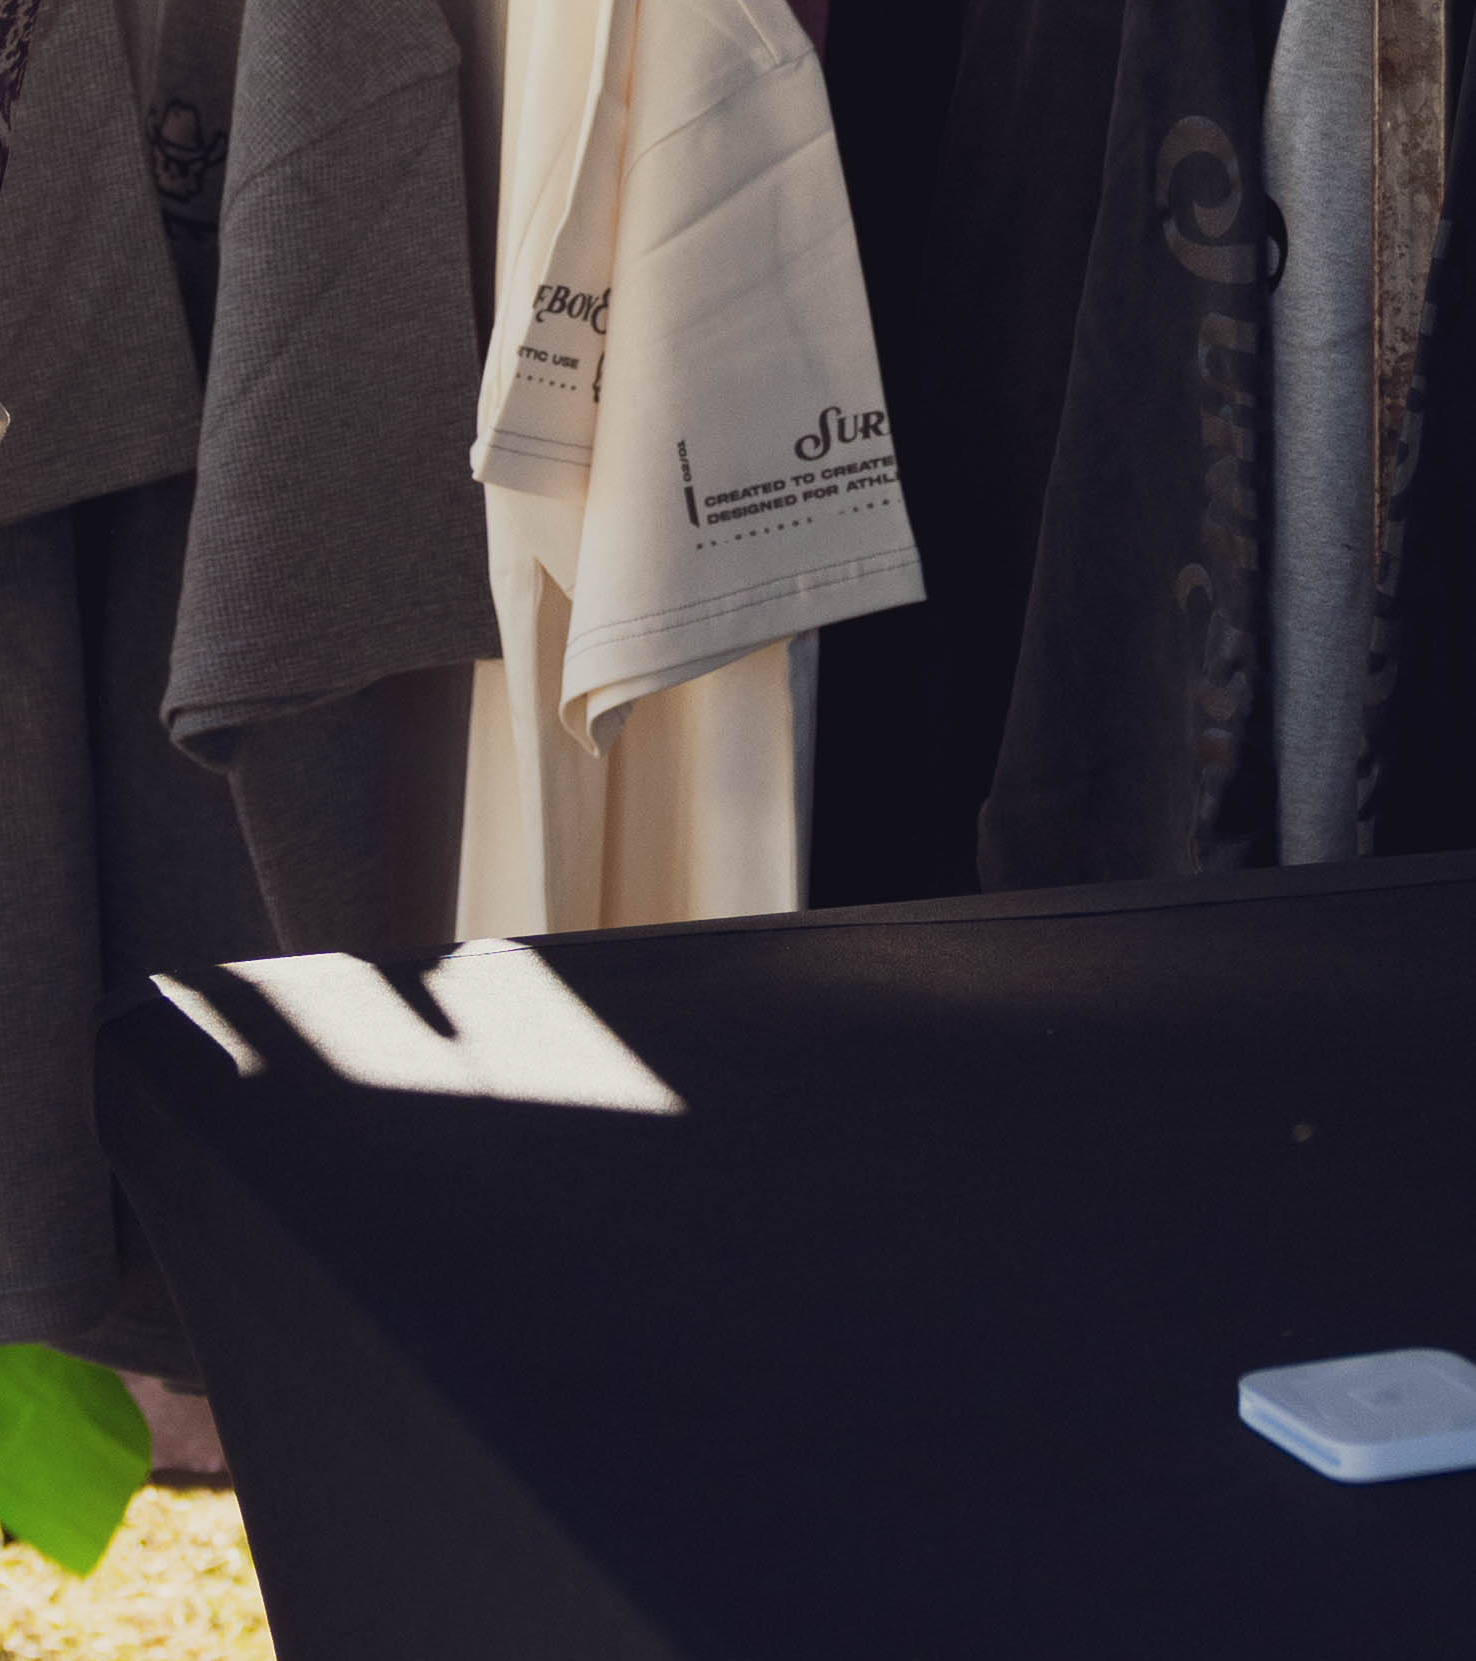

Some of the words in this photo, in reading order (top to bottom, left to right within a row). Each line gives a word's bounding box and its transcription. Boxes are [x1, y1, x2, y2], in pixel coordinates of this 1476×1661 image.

[552, 353, 580, 370] USE
[704, 479, 786, 508] CREATED
[791, 473, 815, 486] TO
[821, 455, 894, 480] CREATE
[707, 494, 797, 525] DESIGNED
[803, 484, 839, 502] FOR
